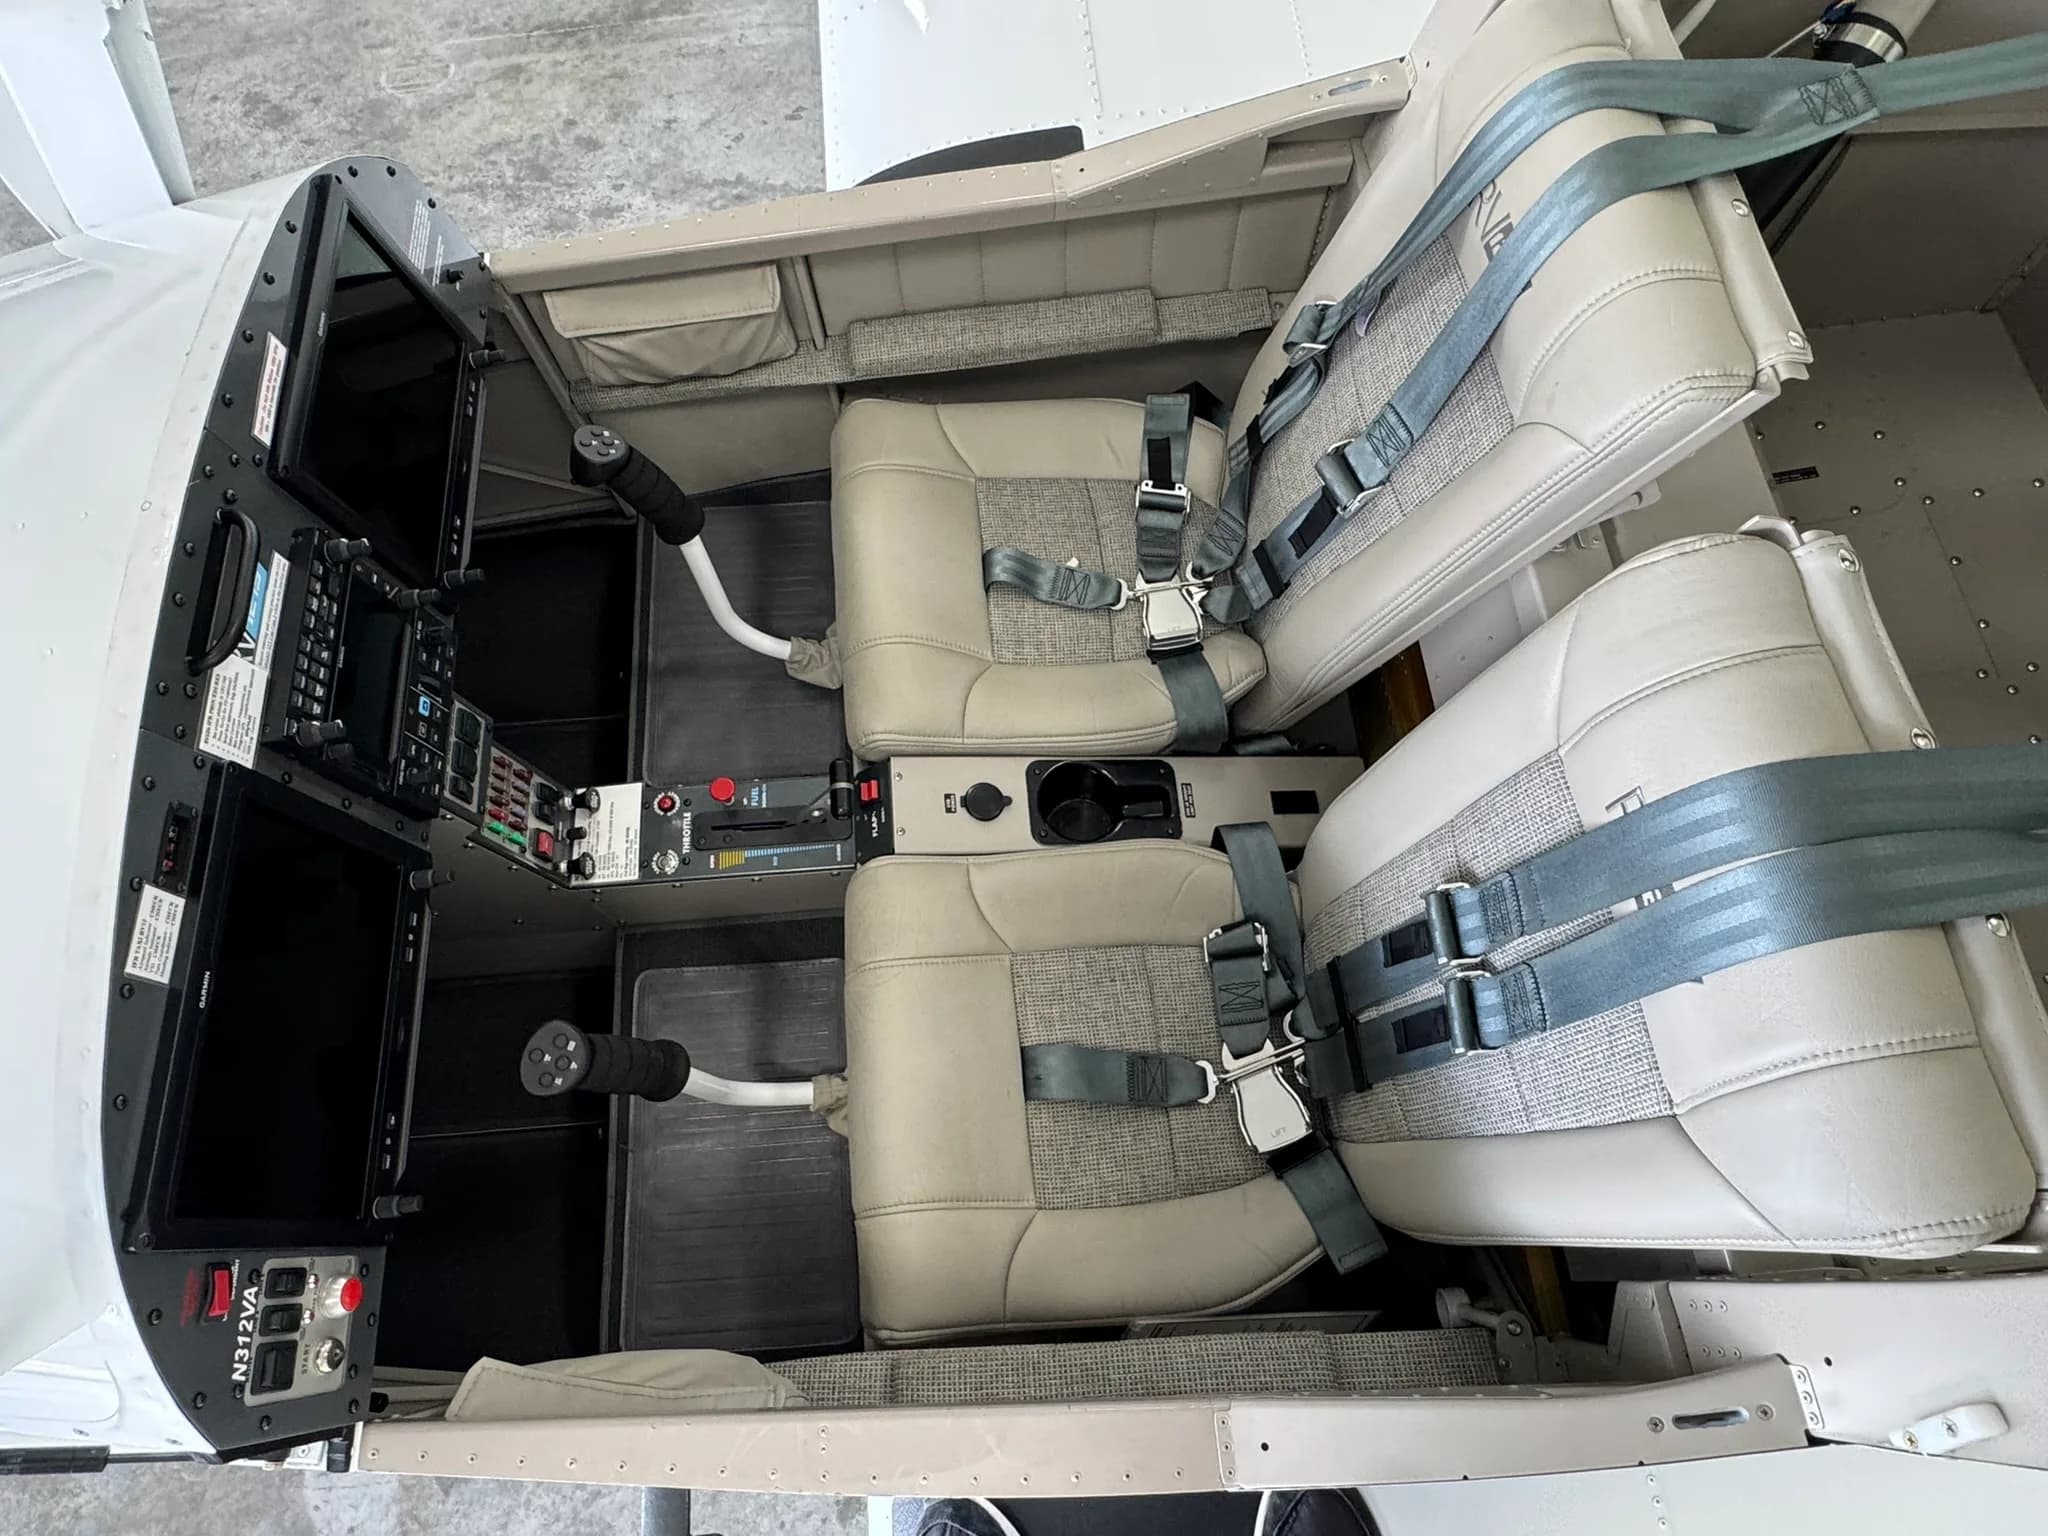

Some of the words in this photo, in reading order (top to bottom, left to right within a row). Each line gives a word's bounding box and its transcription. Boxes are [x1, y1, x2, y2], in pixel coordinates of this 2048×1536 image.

[750, 786, 760, 806] FUEL
[682, 812, 692, 854] THROTTLE
[199, 971, 211, 1008] GARMIN
[231, 1286, 258, 1382] N312VA
[300, 1344, 311, 1375] START
